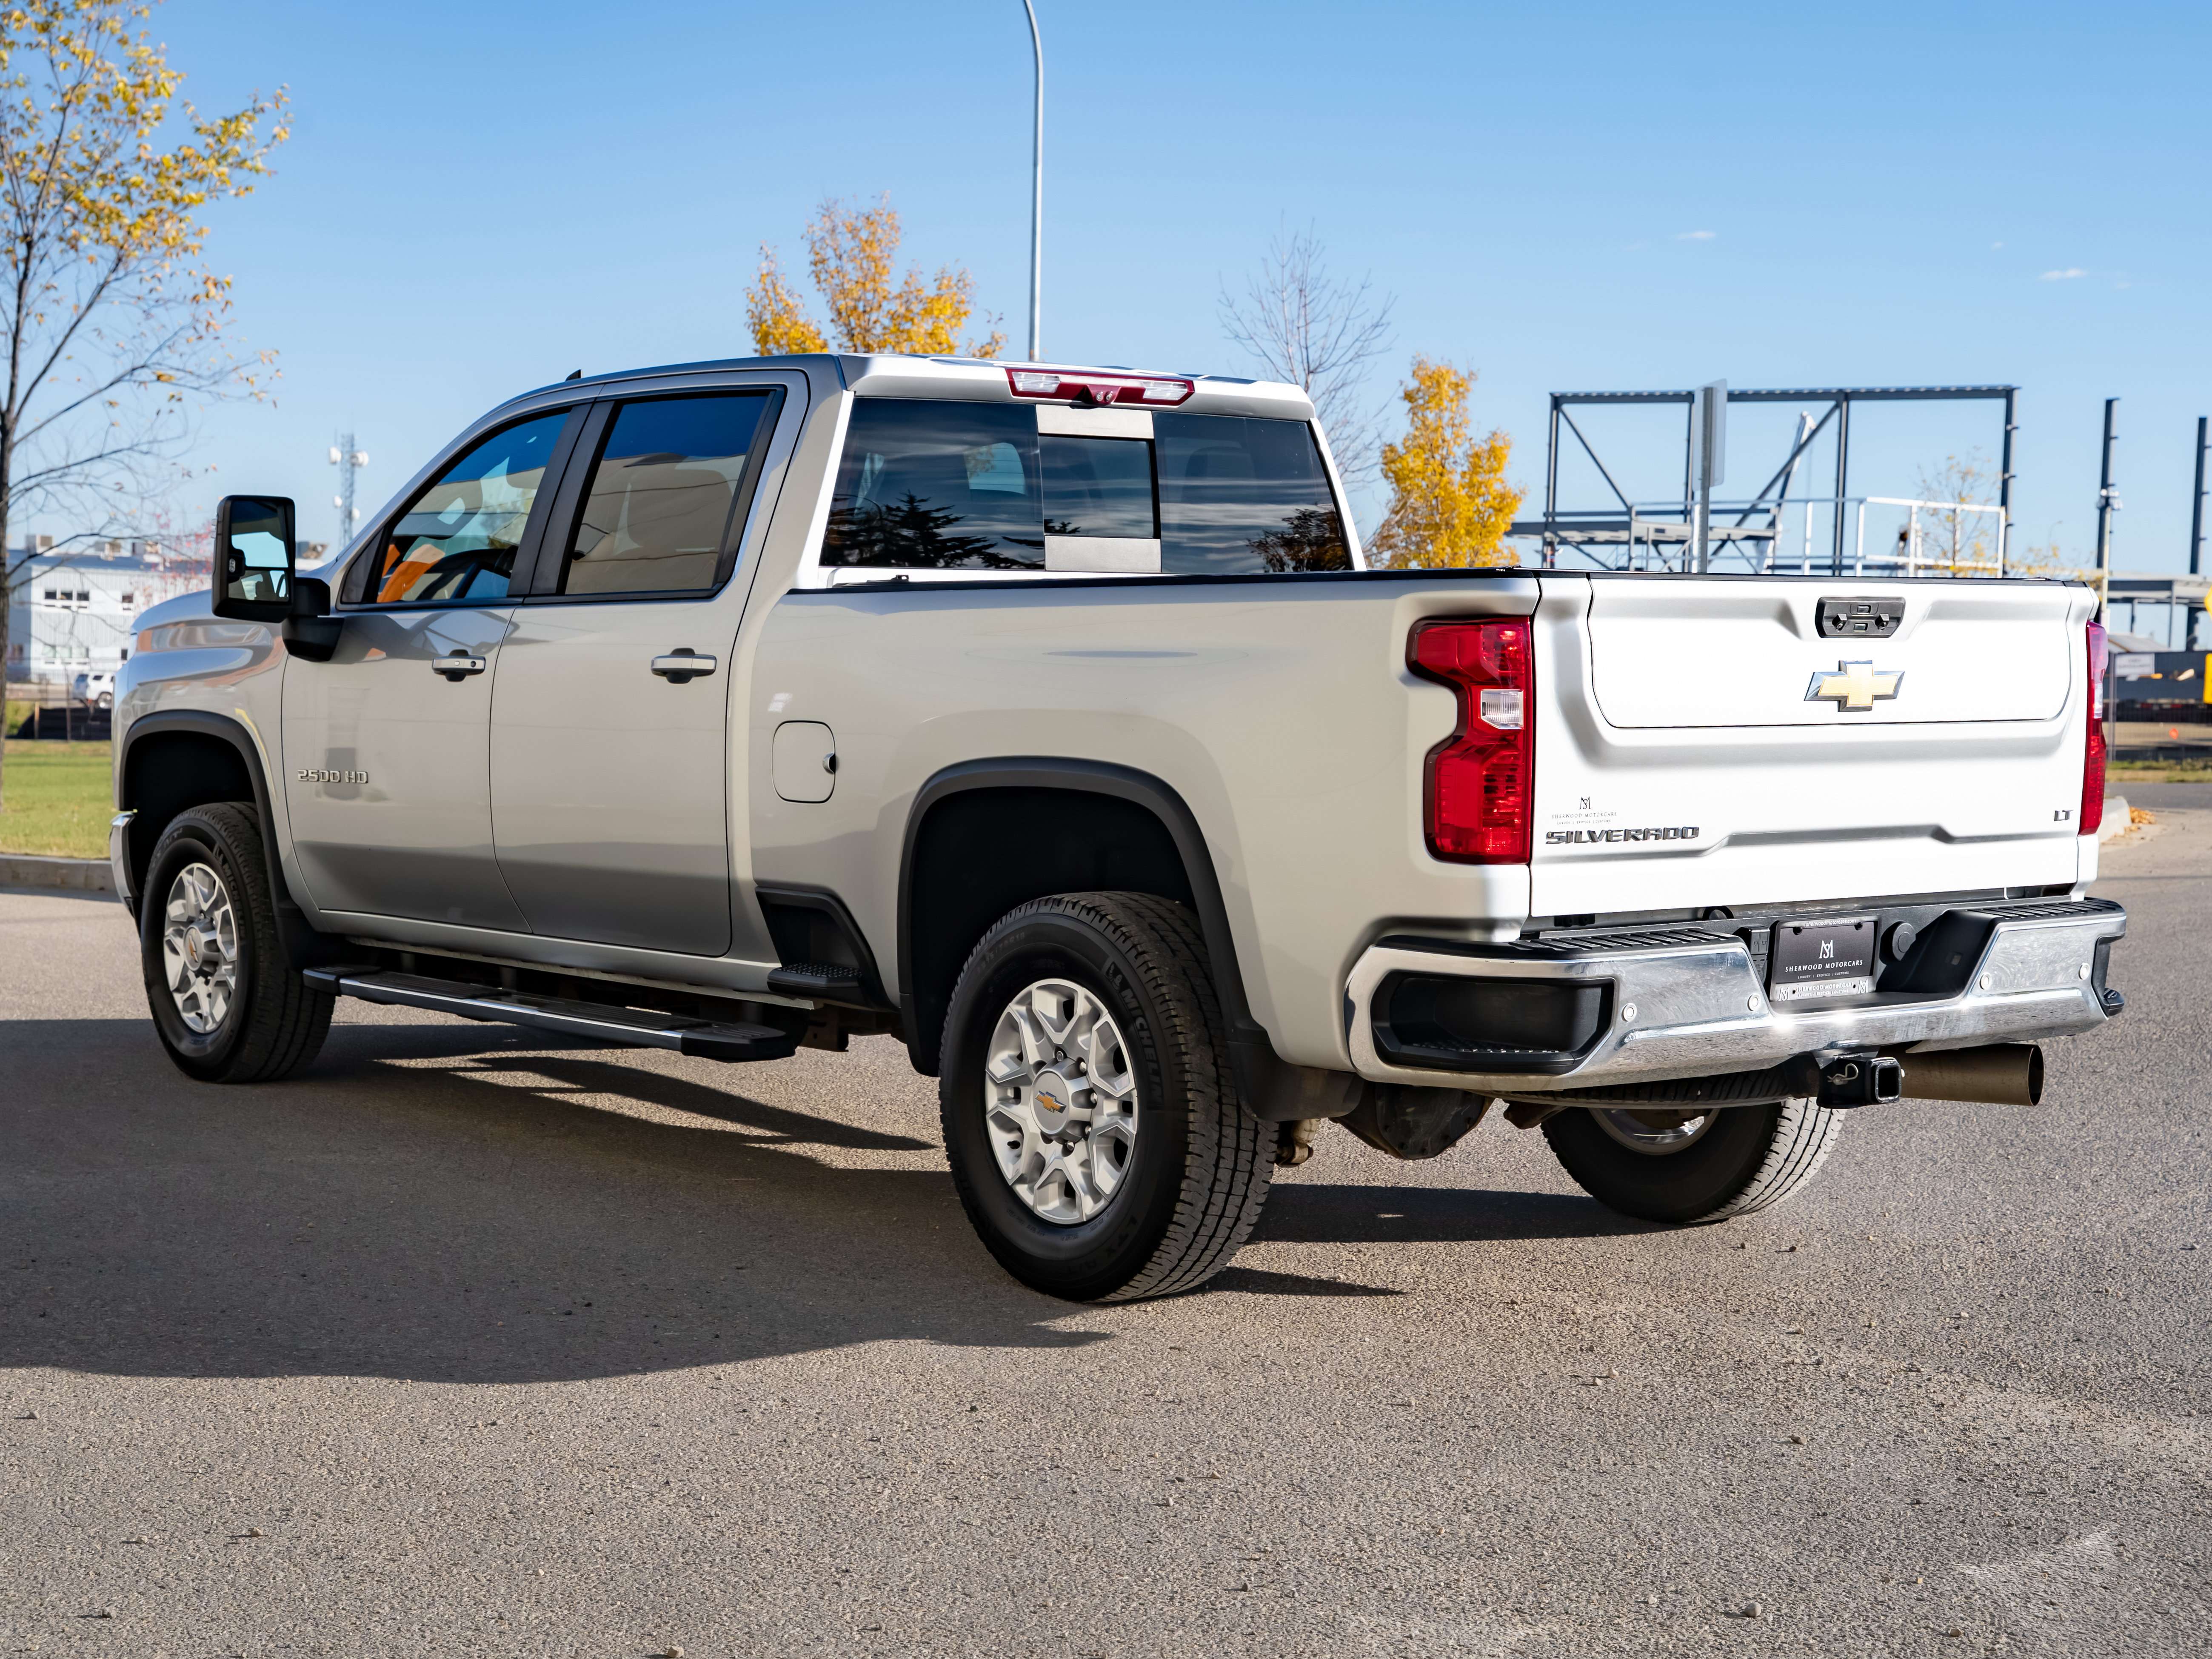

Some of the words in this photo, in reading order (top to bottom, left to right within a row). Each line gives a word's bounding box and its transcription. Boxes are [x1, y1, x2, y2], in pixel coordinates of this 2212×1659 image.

[297, 769, 341, 782] 2500
[345, 771, 368, 784] HD
[2054, 810, 2074, 821] LT
[1545, 826, 1699, 845] SILVERADO
[1805, 919, 1856, 927] sherwoodmotorcars.com
[1785, 963, 1823, 973] SHERWOOD
[1825, 959, 1863, 969] MOTORCARS
[1119, 988, 1163, 1106] MICHELIN
